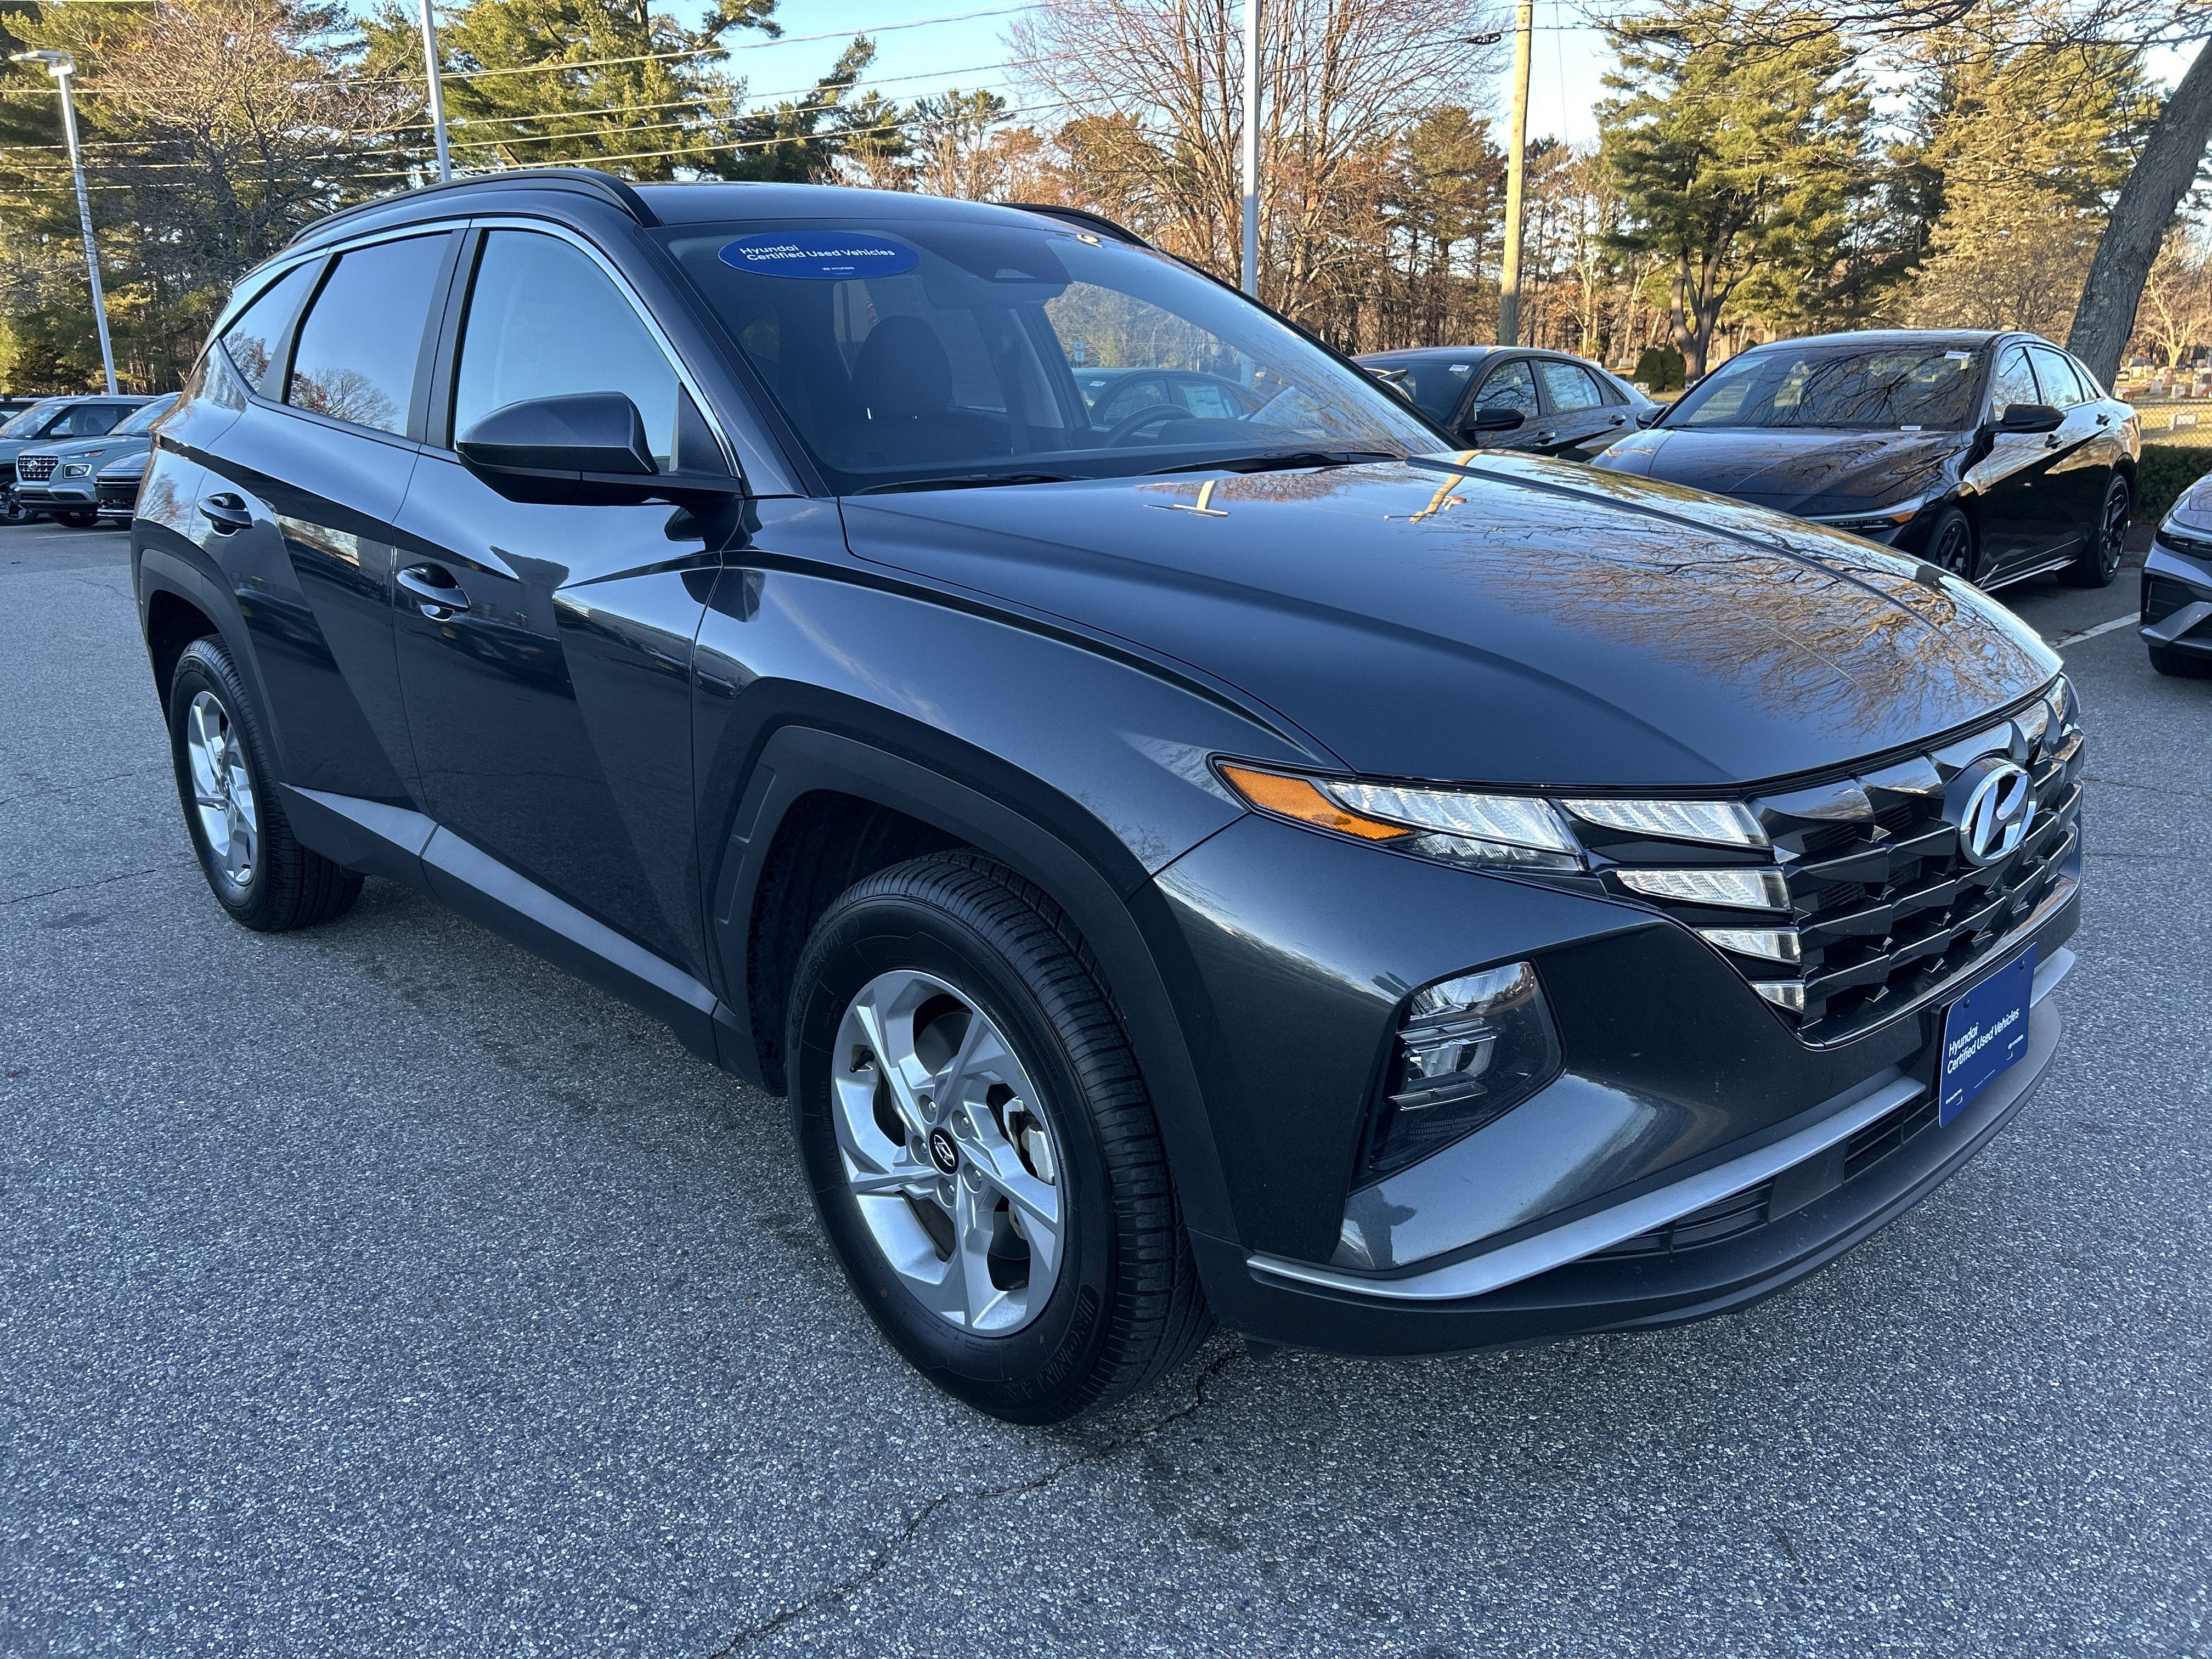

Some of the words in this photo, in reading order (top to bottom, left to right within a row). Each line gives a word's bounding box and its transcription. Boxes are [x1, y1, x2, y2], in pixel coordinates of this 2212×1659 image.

[739, 245, 799, 255] Hyundai
[747, 251, 806, 261] Certified
[1947, 1040, 1977, 1074] Certified
[1977, 1025, 1994, 1050] Used
[1994, 1008, 2019, 1036] Vehicles
[1948, 1022, 1979, 1058] Hyundai
[1003, 1292, 1096, 1403] IRONMAN
